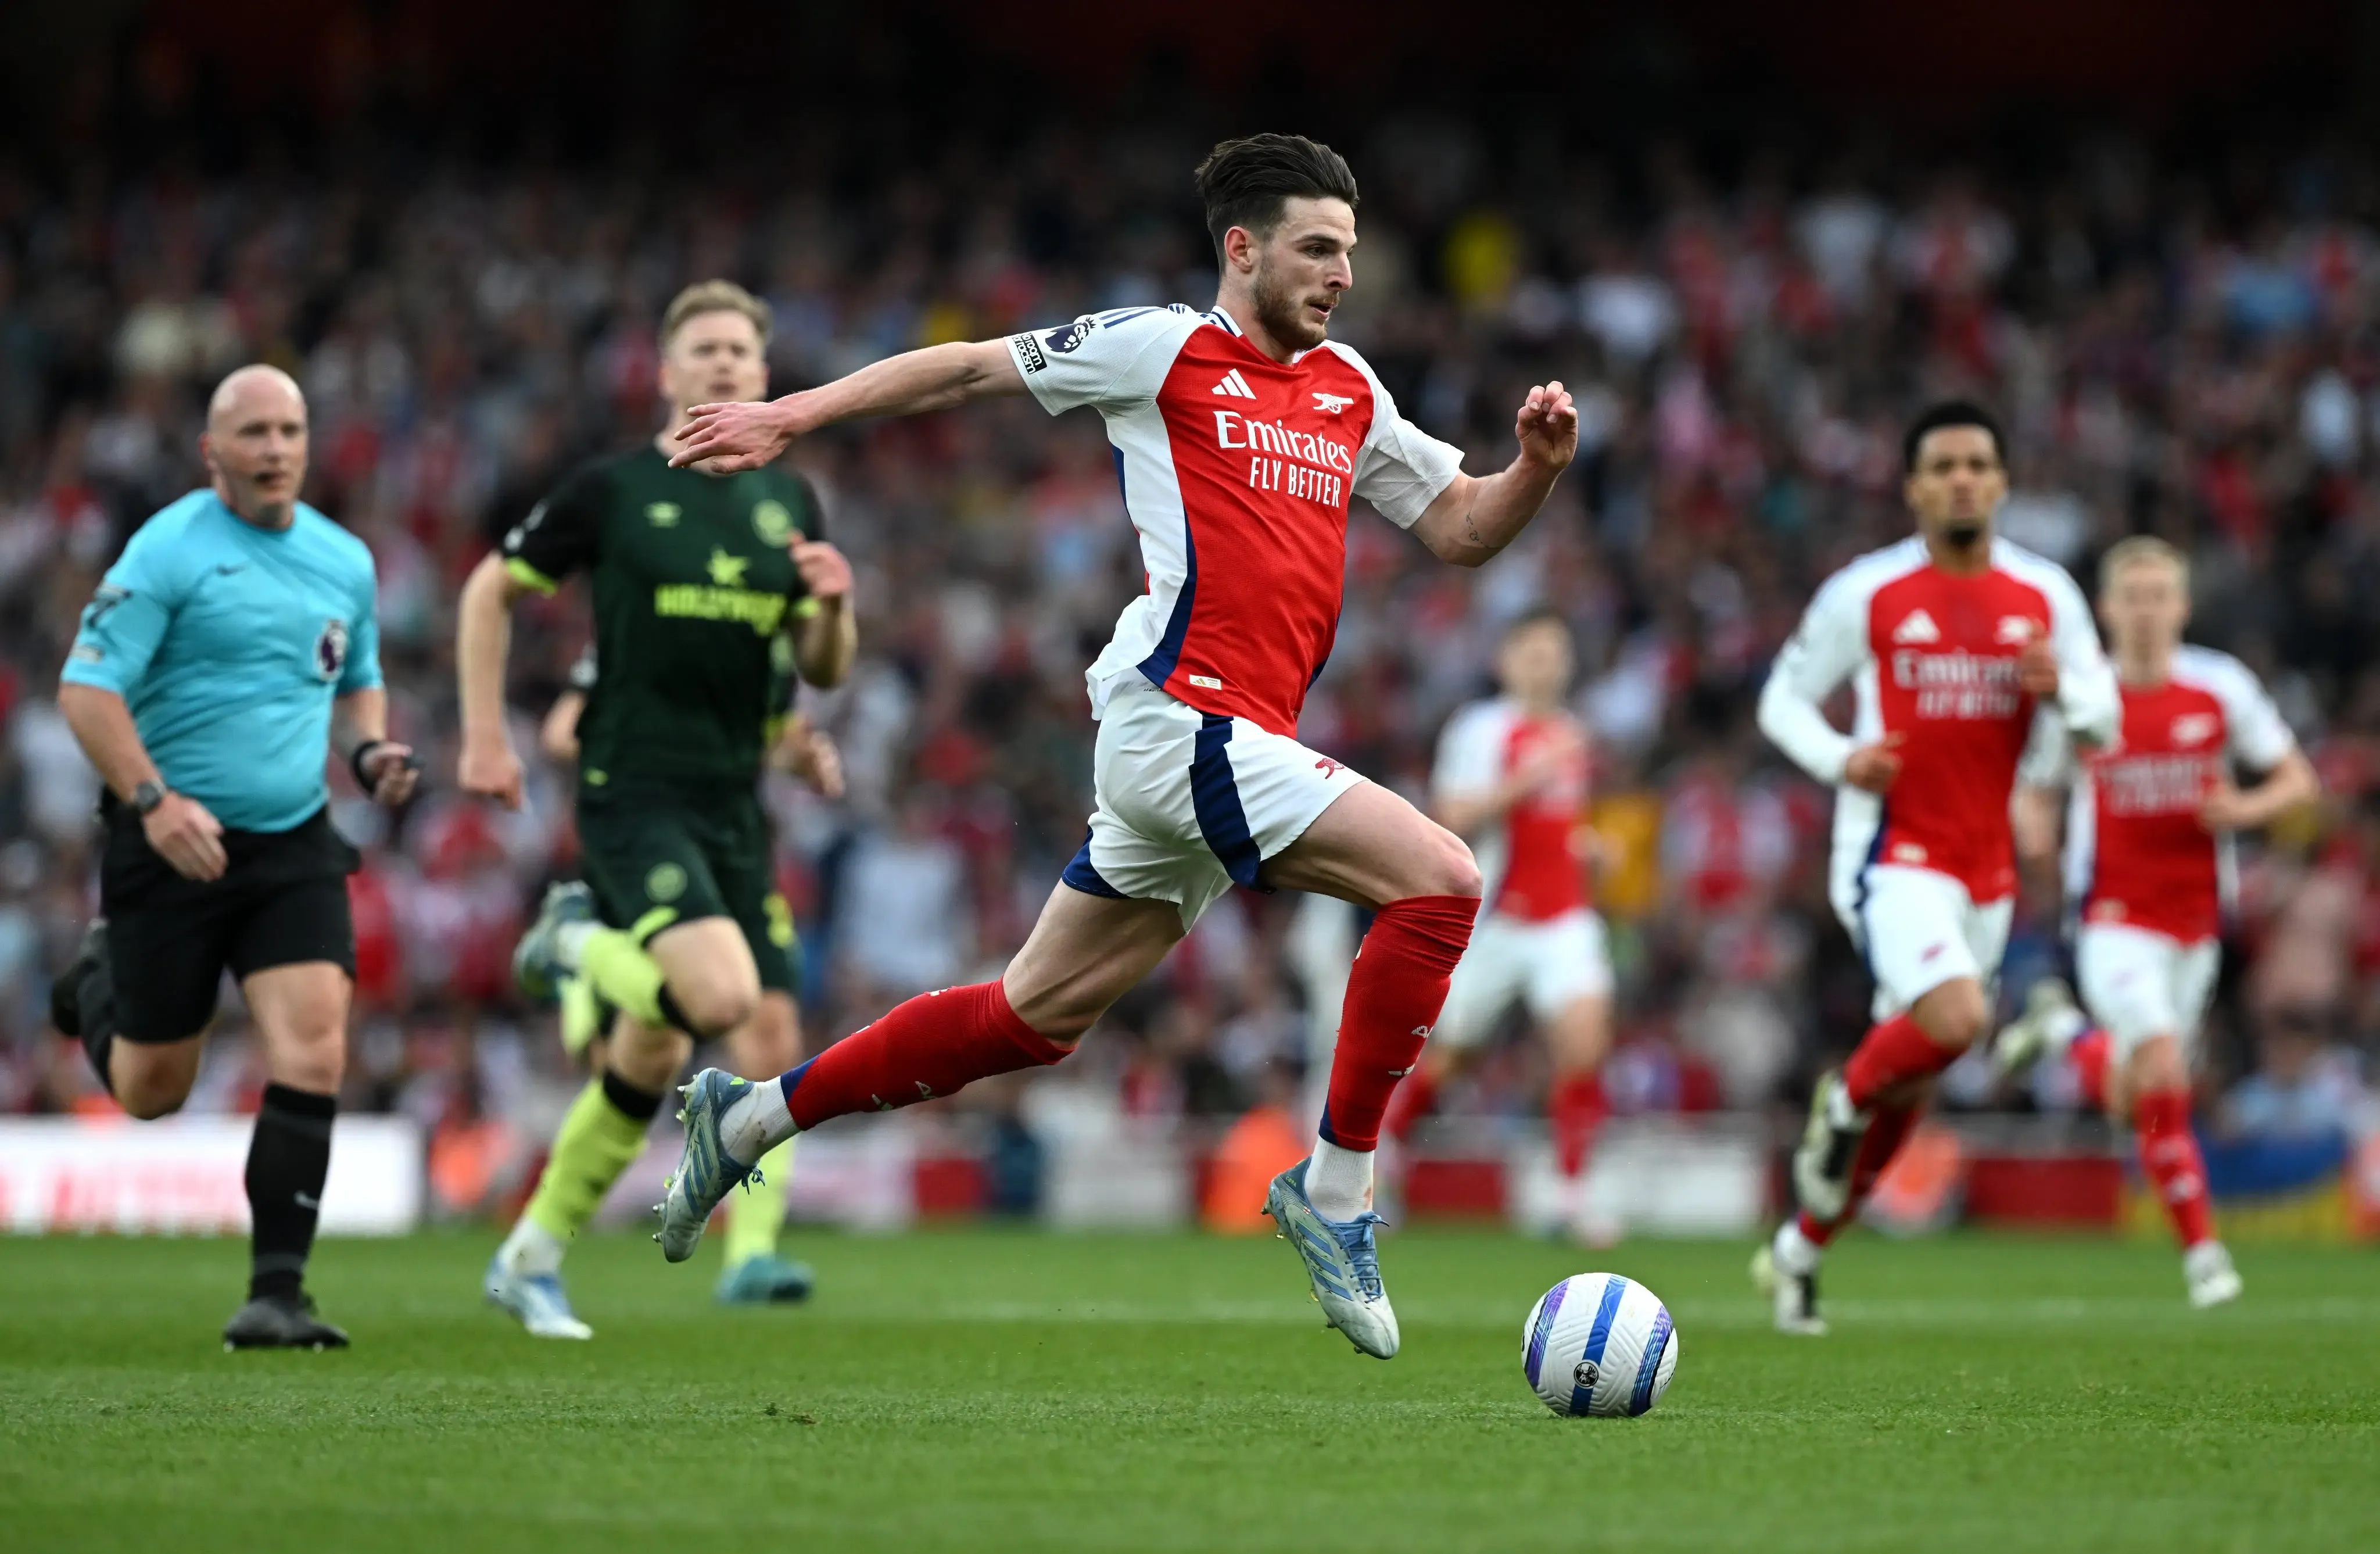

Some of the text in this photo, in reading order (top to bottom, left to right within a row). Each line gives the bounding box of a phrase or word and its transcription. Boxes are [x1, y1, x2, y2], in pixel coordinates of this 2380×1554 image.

[1016, 342, 1036, 374] racism
[1025, 339, 1042, 366] room
[1213, 411, 1352, 474] Emirates
[1249, 457, 1341, 508] FLY BETTER
